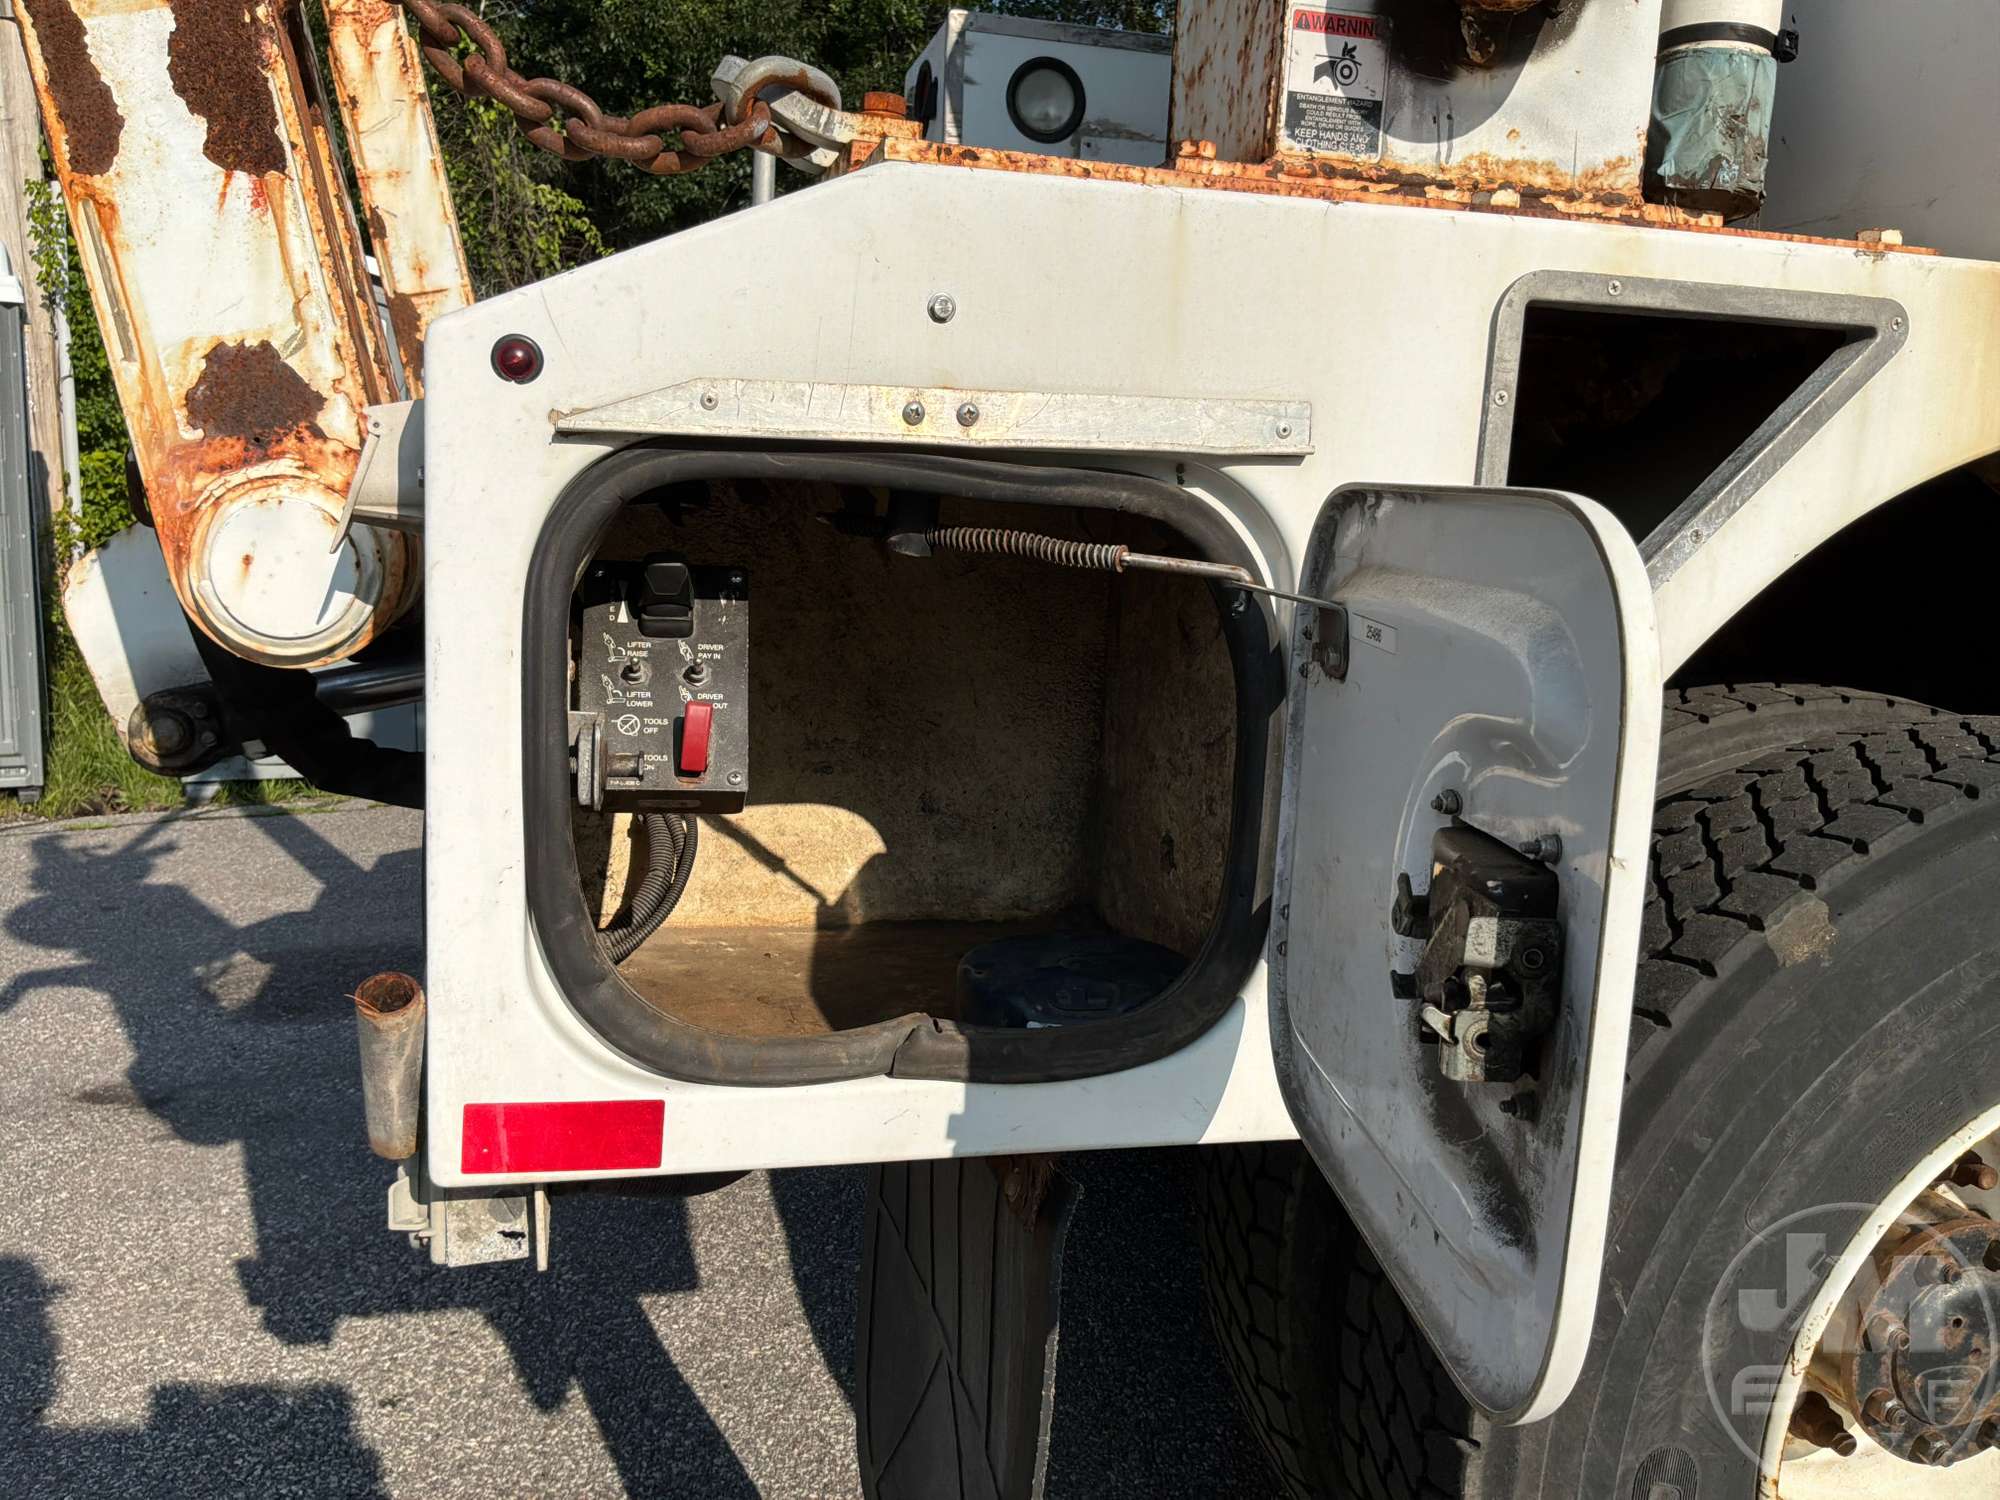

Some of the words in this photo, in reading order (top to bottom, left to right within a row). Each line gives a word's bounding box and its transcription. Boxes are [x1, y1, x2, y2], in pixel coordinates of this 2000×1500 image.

[1312, 14, 1375, 36] WARNIN
[1296, 93, 1346, 105] ENTANGLEMENT
[1294, 127, 1318, 138] KEEP
[1319, 129, 1349, 142] HANDS
[1350, 133, 1369, 144] AND
[1296, 137, 1338, 150] CLOTHING
[626, 641, 652, 649] LIFTER
[697, 643, 724, 651] DRIVER
[626, 650, 649, 658] RAISE
[626, 691, 652, 699] LIFTER
[697, 692, 724, 700] DRIVER
[626, 700, 654, 708] LOWER
[643, 717, 669, 726] TOOLS
[643, 727, 659, 735] OFF
[643, 753, 669, 762] TOOLS
